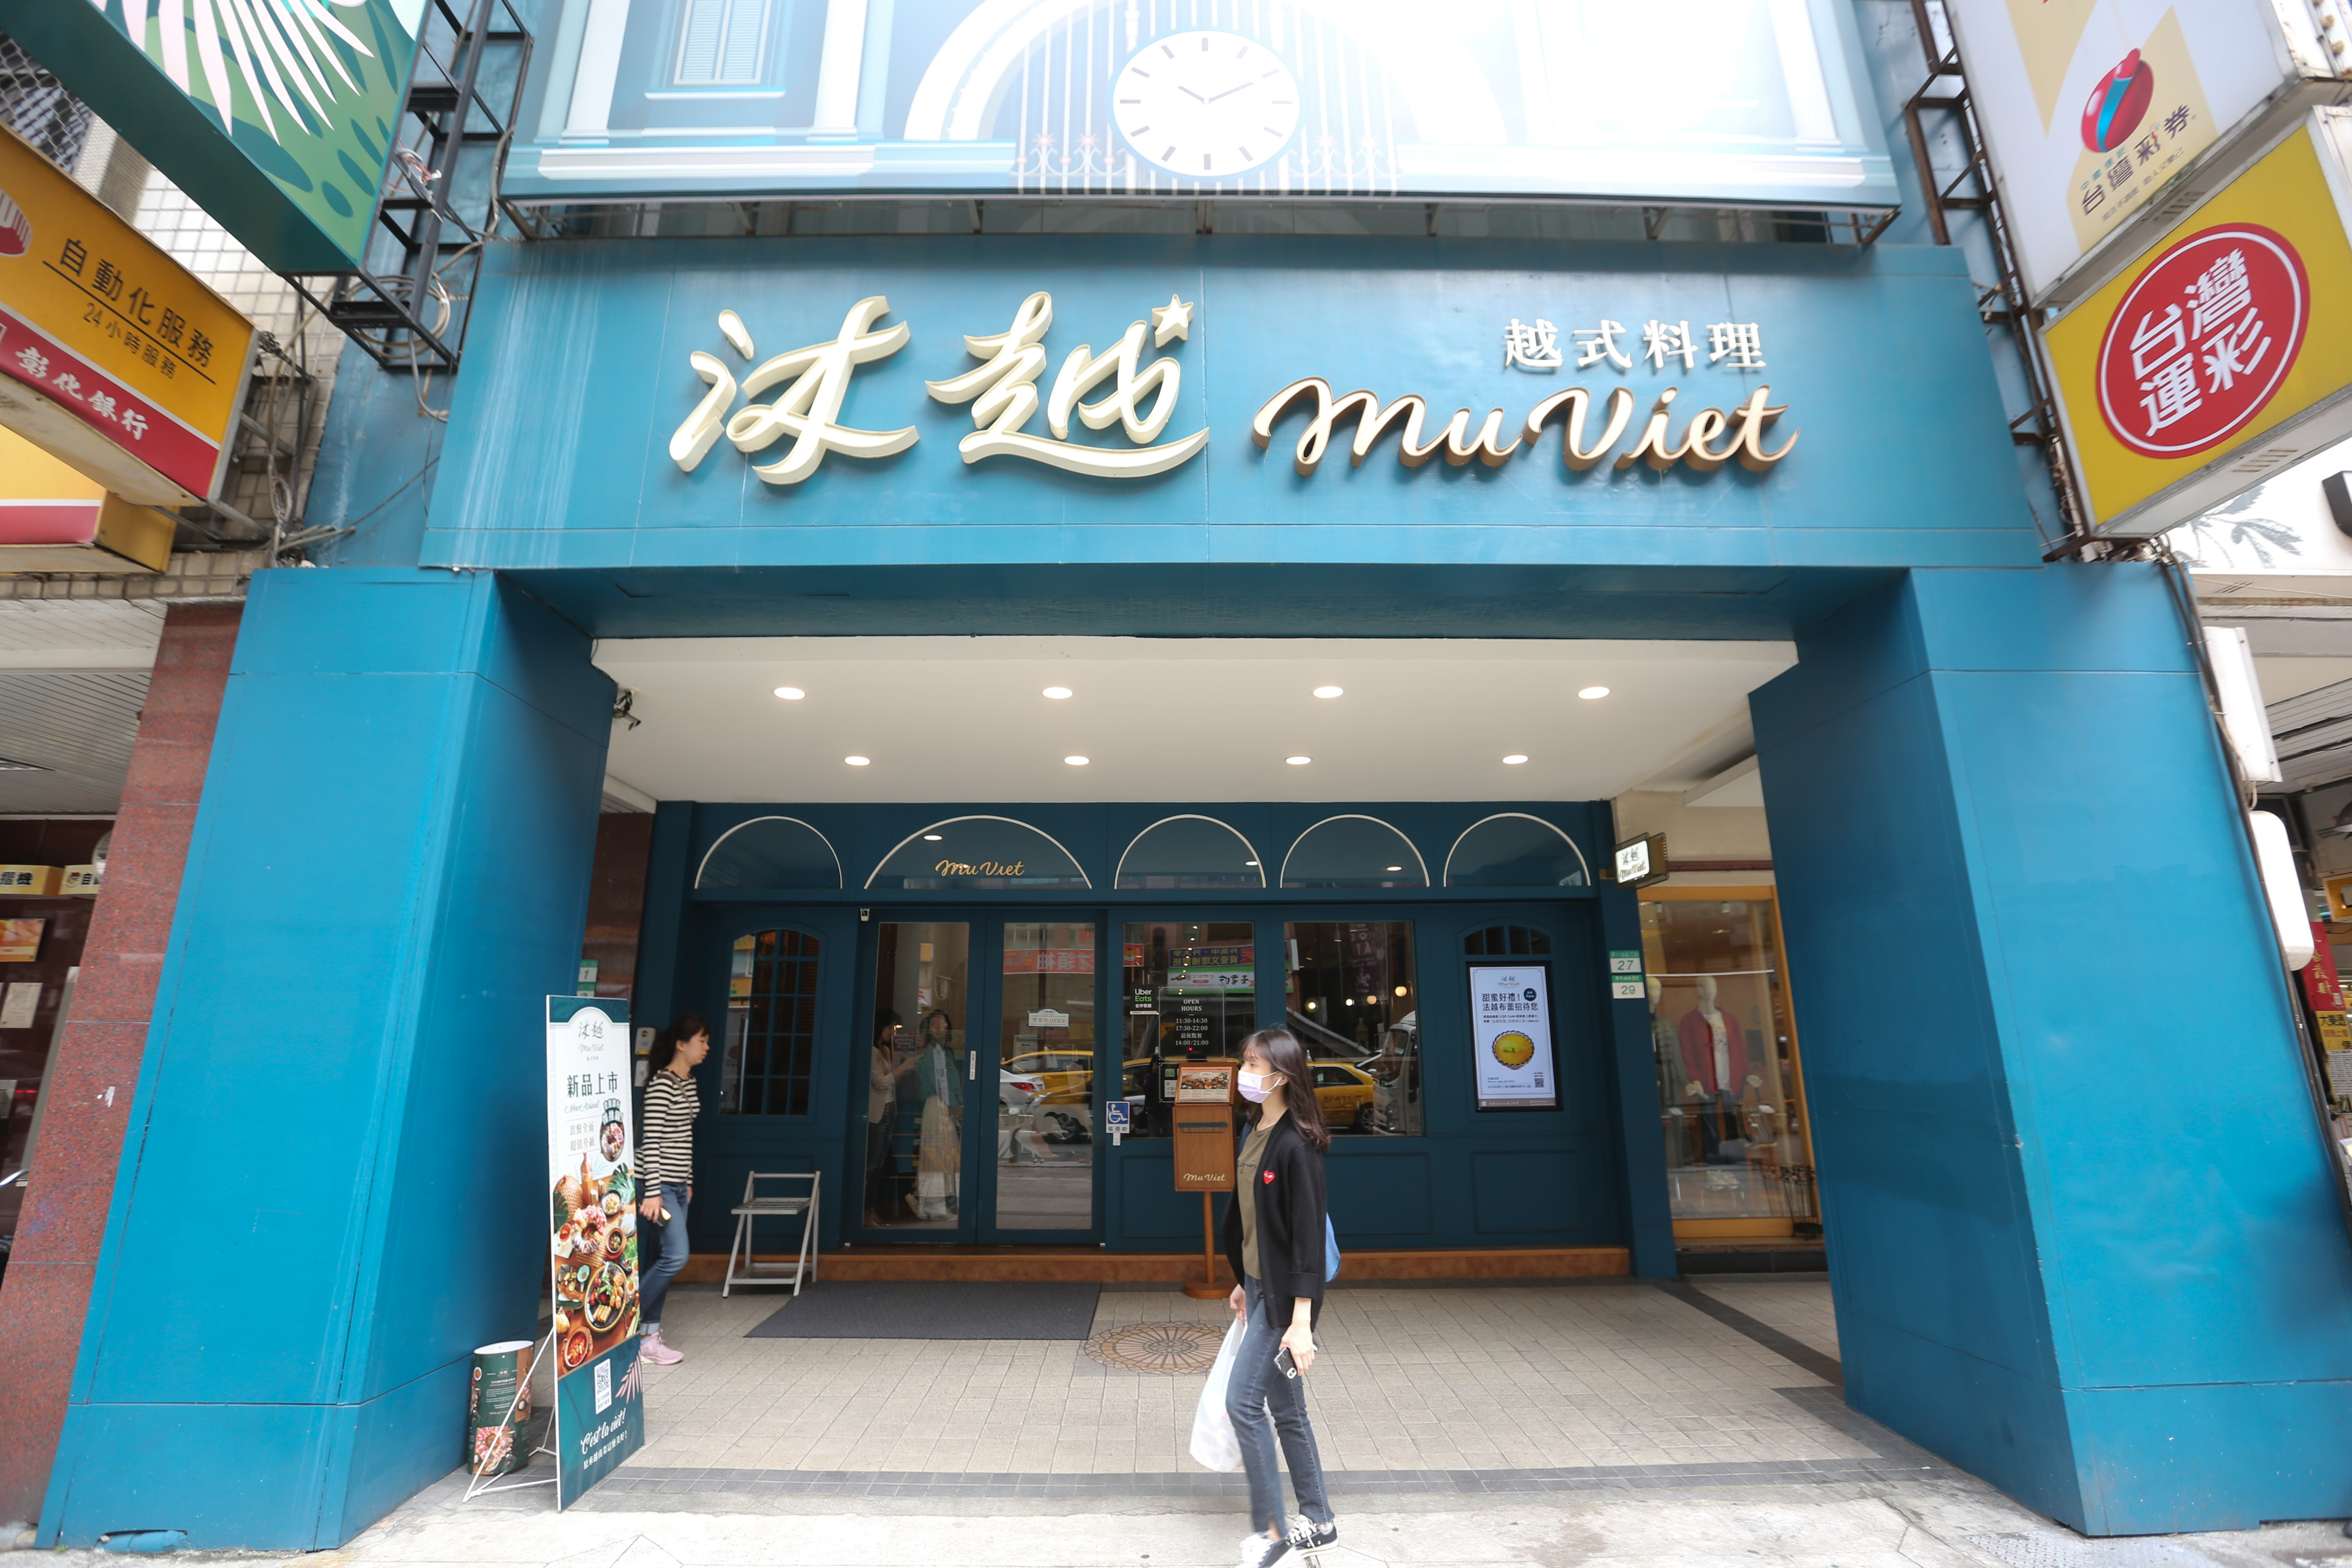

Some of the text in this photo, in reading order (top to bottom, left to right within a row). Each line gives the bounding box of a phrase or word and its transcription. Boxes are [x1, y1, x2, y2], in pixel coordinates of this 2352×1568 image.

[2081, 104, 2191, 216] 台灣彩券
[58, 237, 215, 369] 自動化服務
[2129, 248, 2253, 382] 台灣
[1502, 316, 1768, 372] 越式料理
[2140, 307, 2271, 438] 運彩
[14, 345, 149, 441] 彰化銀行
[1618, 960, 1634, 970] 27
[1621, 985, 1636, 995] 29
[1483, 1002, 1539, 1011] 法越布蕾招待您
[2319, 1014, 2347, 1026] 大樂透
[567, 1071, 618, 1098] 新品上市
[570, 1122, 595, 1136] 套餐全面
[570, 1136, 595, 1151] 超值升級
[580, 1426, 602, 1455] C'est
[601, 1421, 610, 1439] la
